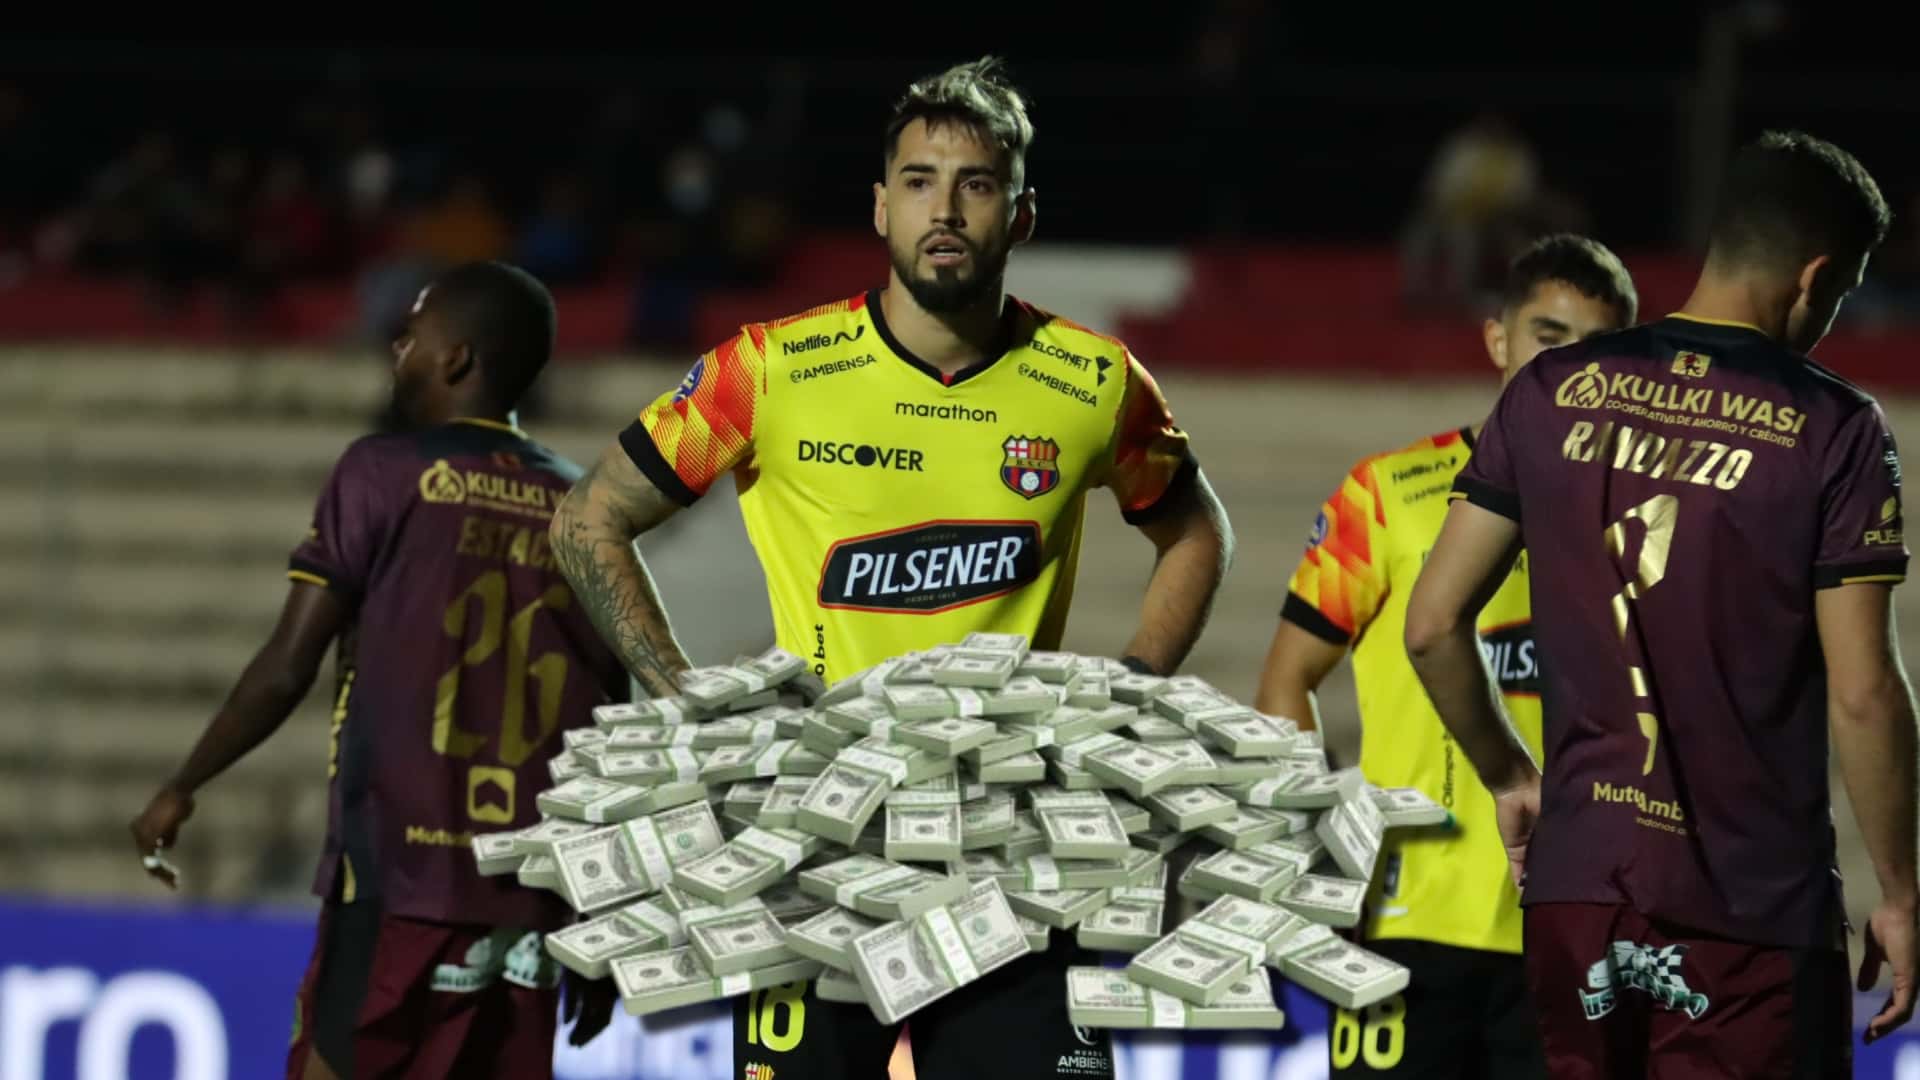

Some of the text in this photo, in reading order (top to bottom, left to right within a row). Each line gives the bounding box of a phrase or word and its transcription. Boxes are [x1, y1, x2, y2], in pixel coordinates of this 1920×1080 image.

[783, 333, 832, 356] Netlife
[895, 401, 998, 424] marathon
[1610, 372, 1806, 434] KULLKI WASI
[1676, 414, 1691, 425] DE
[1692, 417, 1738, 434] AHORRO
[798, 439, 924, 472] DISCOVER
[466, 471, 546, 507] KULLKI
[843, 536, 1023, 598] PILSENER
